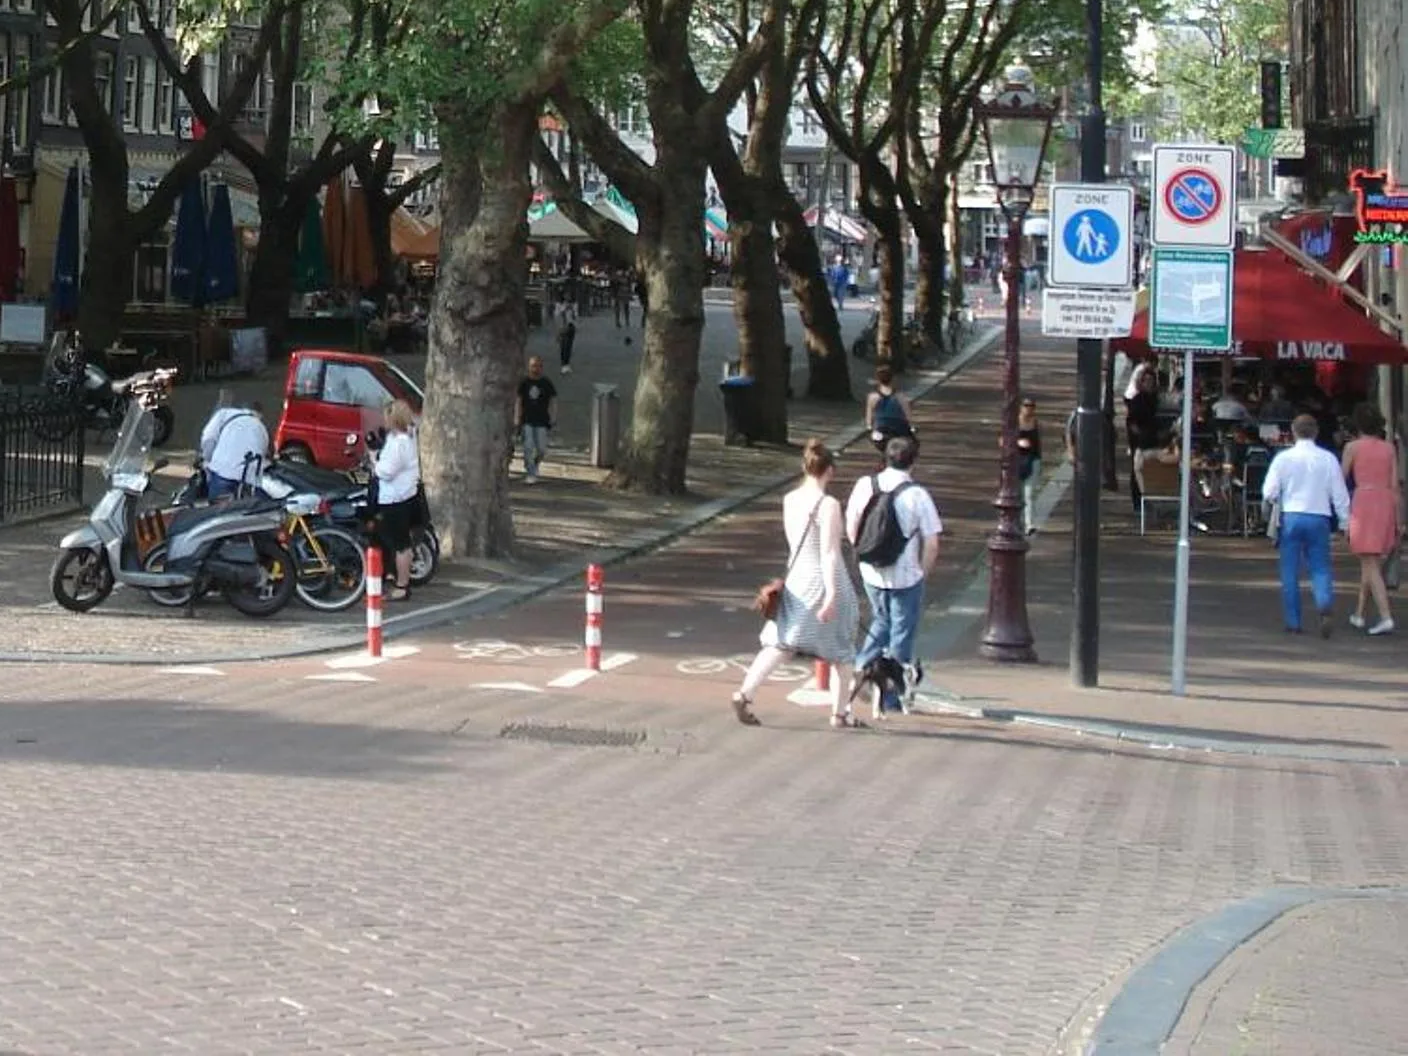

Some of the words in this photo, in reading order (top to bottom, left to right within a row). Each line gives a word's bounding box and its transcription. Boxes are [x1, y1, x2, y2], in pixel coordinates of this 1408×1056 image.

[1176, 152, 1212, 163] ZONE
[1075, 194, 1110, 205] ZONE
[1277, 340, 1298, 359] LA
[1302, 340, 1345, 360] VACA
